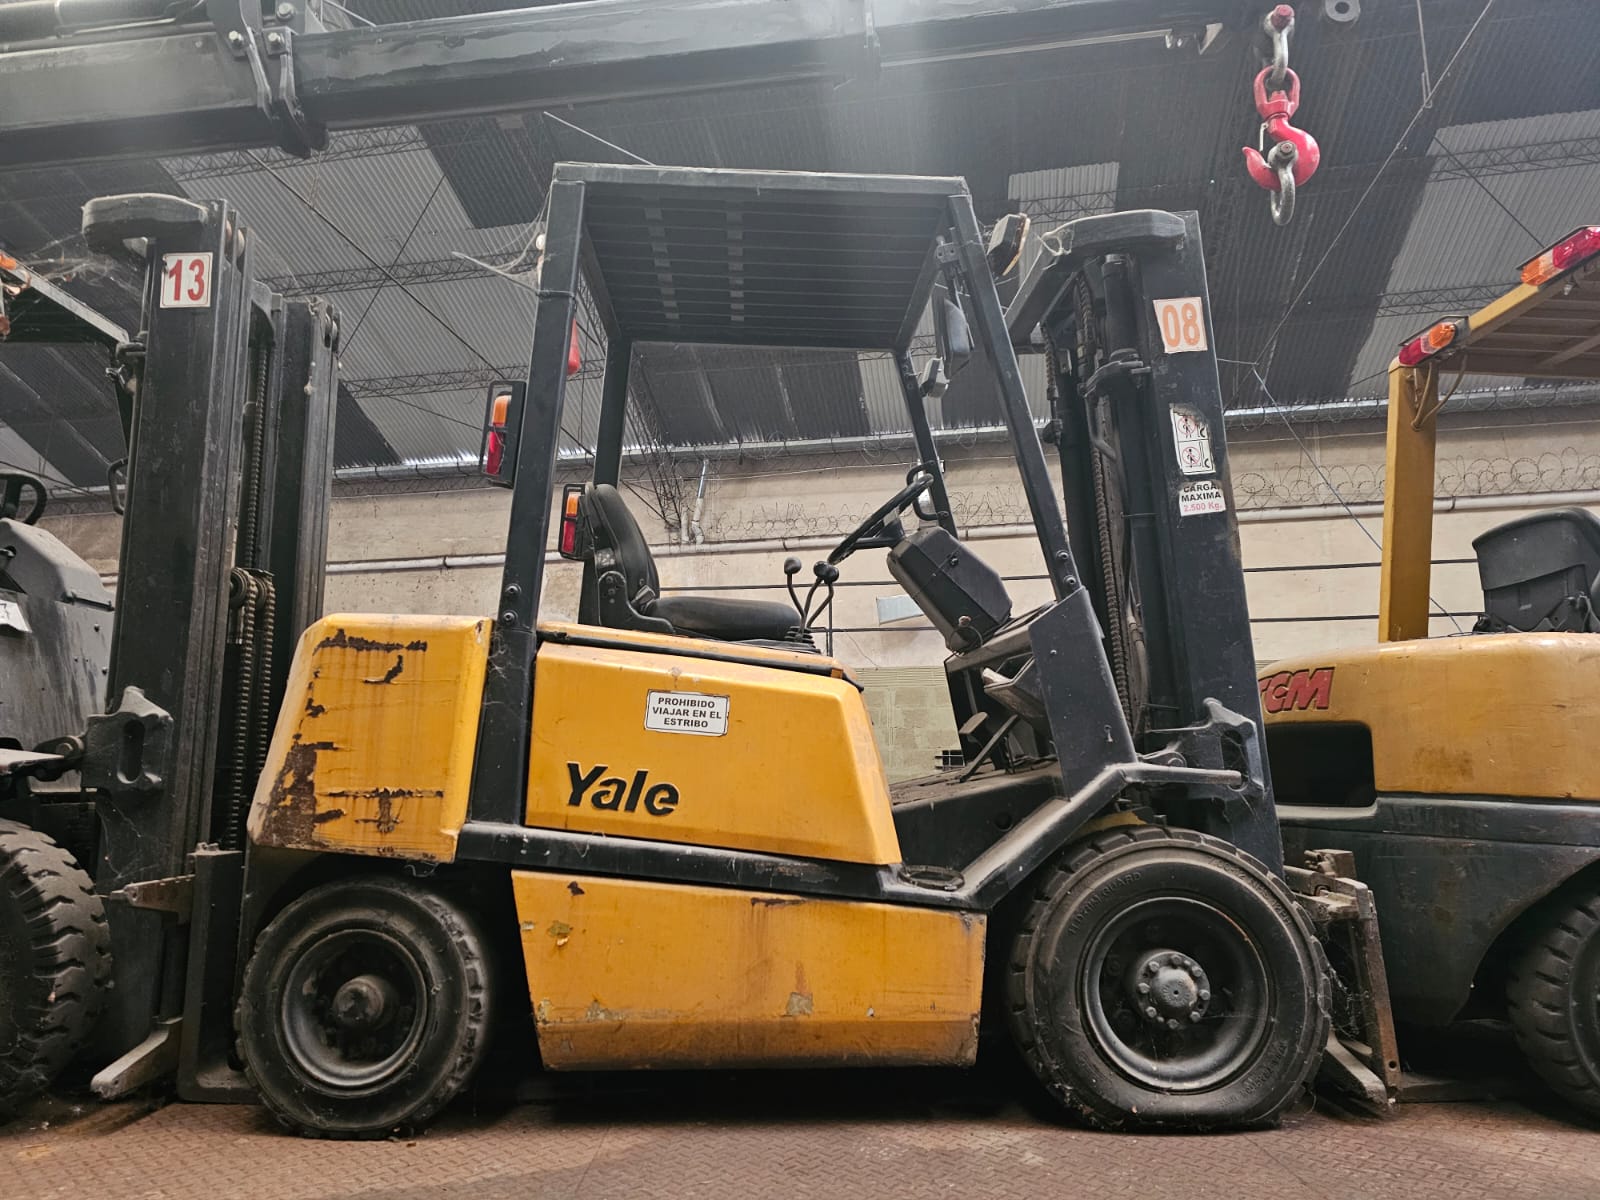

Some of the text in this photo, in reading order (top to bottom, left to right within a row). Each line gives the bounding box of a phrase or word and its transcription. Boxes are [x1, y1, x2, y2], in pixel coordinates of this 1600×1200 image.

[169, 259, 205, 301] 13
[1162, 303, 1200, 347] 08
[1183, 482, 1218, 493] CARGA
[1181, 491, 1222, 502] MAXIMA
[1184, 502, 1206, 512] 2.500
[658, 697, 715, 709] PROHIBIDO
[652, 706, 722, 719] VIAJAR EN EL
[664, 717, 708, 728] ESTRIBO
[566, 761, 680, 816] Yale
